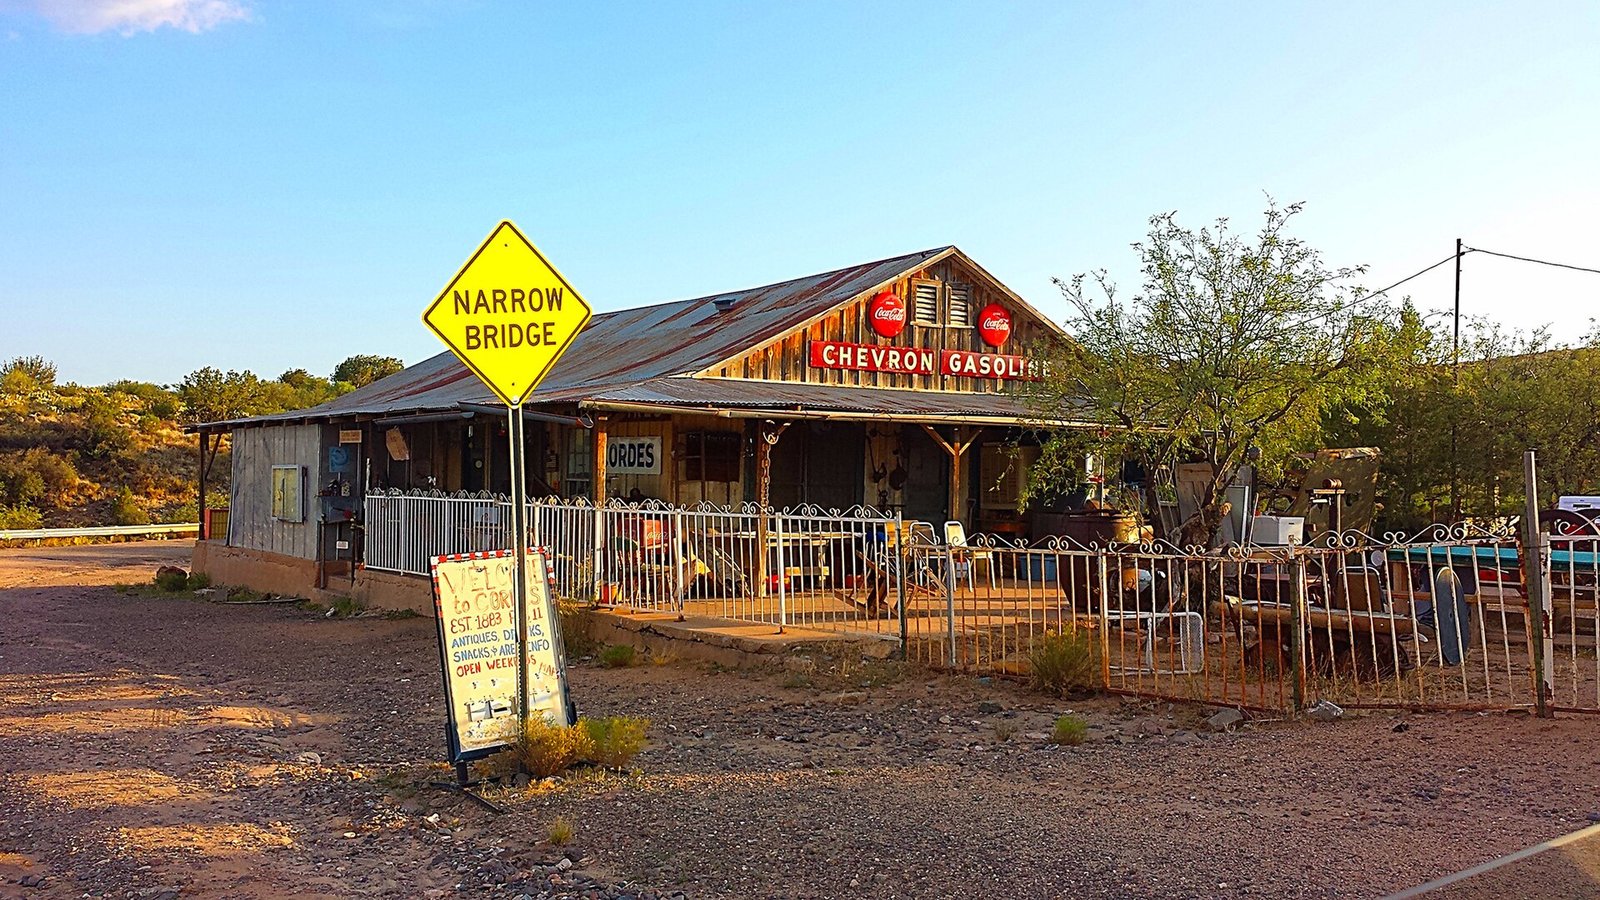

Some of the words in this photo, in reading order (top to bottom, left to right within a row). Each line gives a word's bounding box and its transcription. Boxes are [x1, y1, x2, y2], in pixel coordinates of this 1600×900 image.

[453, 287, 563, 315] NARROW
[874, 306, 904, 321] Coca-Cola
[465, 322, 557, 350] BRIDGE
[822, 345, 933, 371] CHEVRON
[606, 443, 655, 468] ORDES
[443, 559, 543, 594] WELCE
[454, 595, 470, 615] to
[475, 586, 542, 612] CORS
[450, 616, 472, 634] EST.
[476, 612, 502, 630] 1883
[451, 631, 500, 648] ANTIQUES,
[503, 624, 545, 641] DRKS,
[499, 643, 516, 657] ARE
[456, 661, 481, 677] OPEN
[486, 654, 537, 670] WEEKEDS
